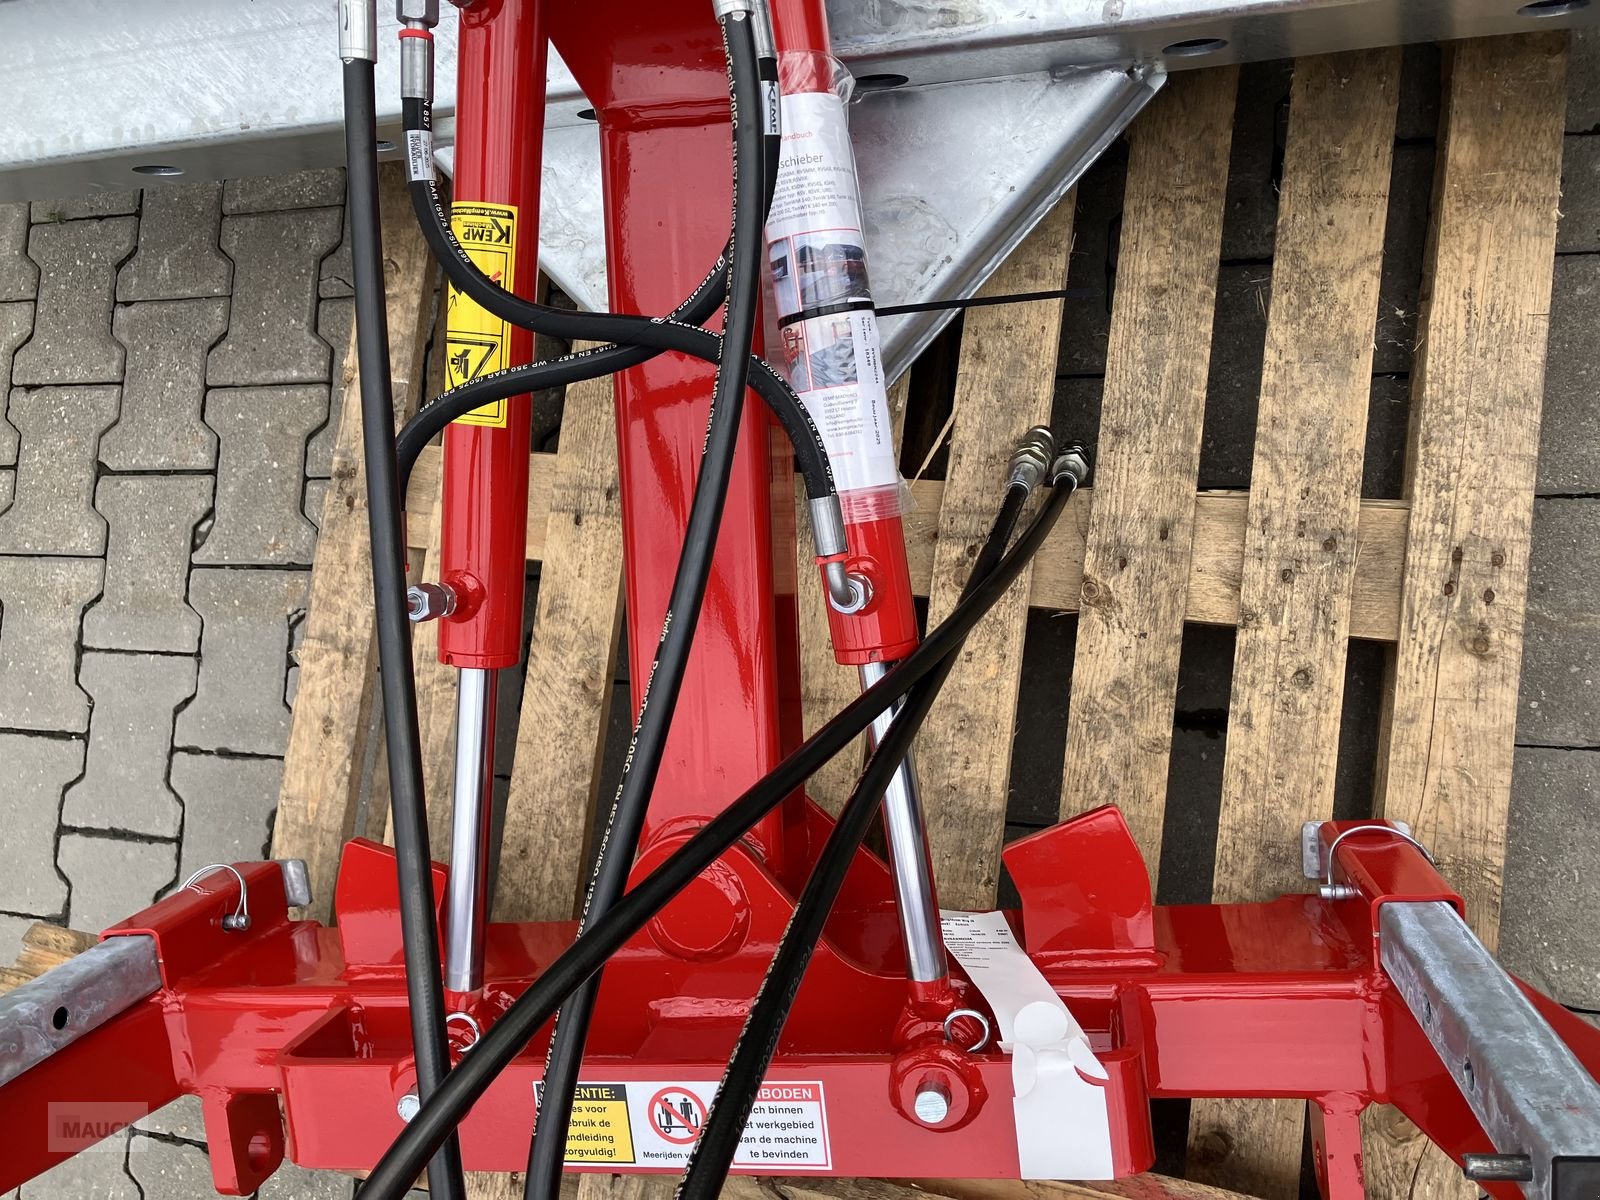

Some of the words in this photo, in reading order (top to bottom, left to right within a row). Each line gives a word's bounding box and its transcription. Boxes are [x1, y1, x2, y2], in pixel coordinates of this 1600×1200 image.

[780, 154, 824, 168] schieber
[429, 180, 439, 199] BAR
[434, 203, 447, 231] (5075
[462, 218, 510, 244] KEMP
[669, 319, 722, 338] Exovatio
[530, 359, 546, 368] WP
[761, 360, 784, 382] DN08
[807, 418, 817, 432] EN
[768, 1106, 804, 1114] binnen
[599, 1120, 610, 1128] de
[756, 1120, 814, 1131] werkgebied
[760, 1136, 772, 1144] de
[774, 1136, 818, 1144] machine
[643, 1151, 680, 1160] Meerijden
[750, 1150, 760, 1158] te
[762, 1150, 809, 1158] bevinden
